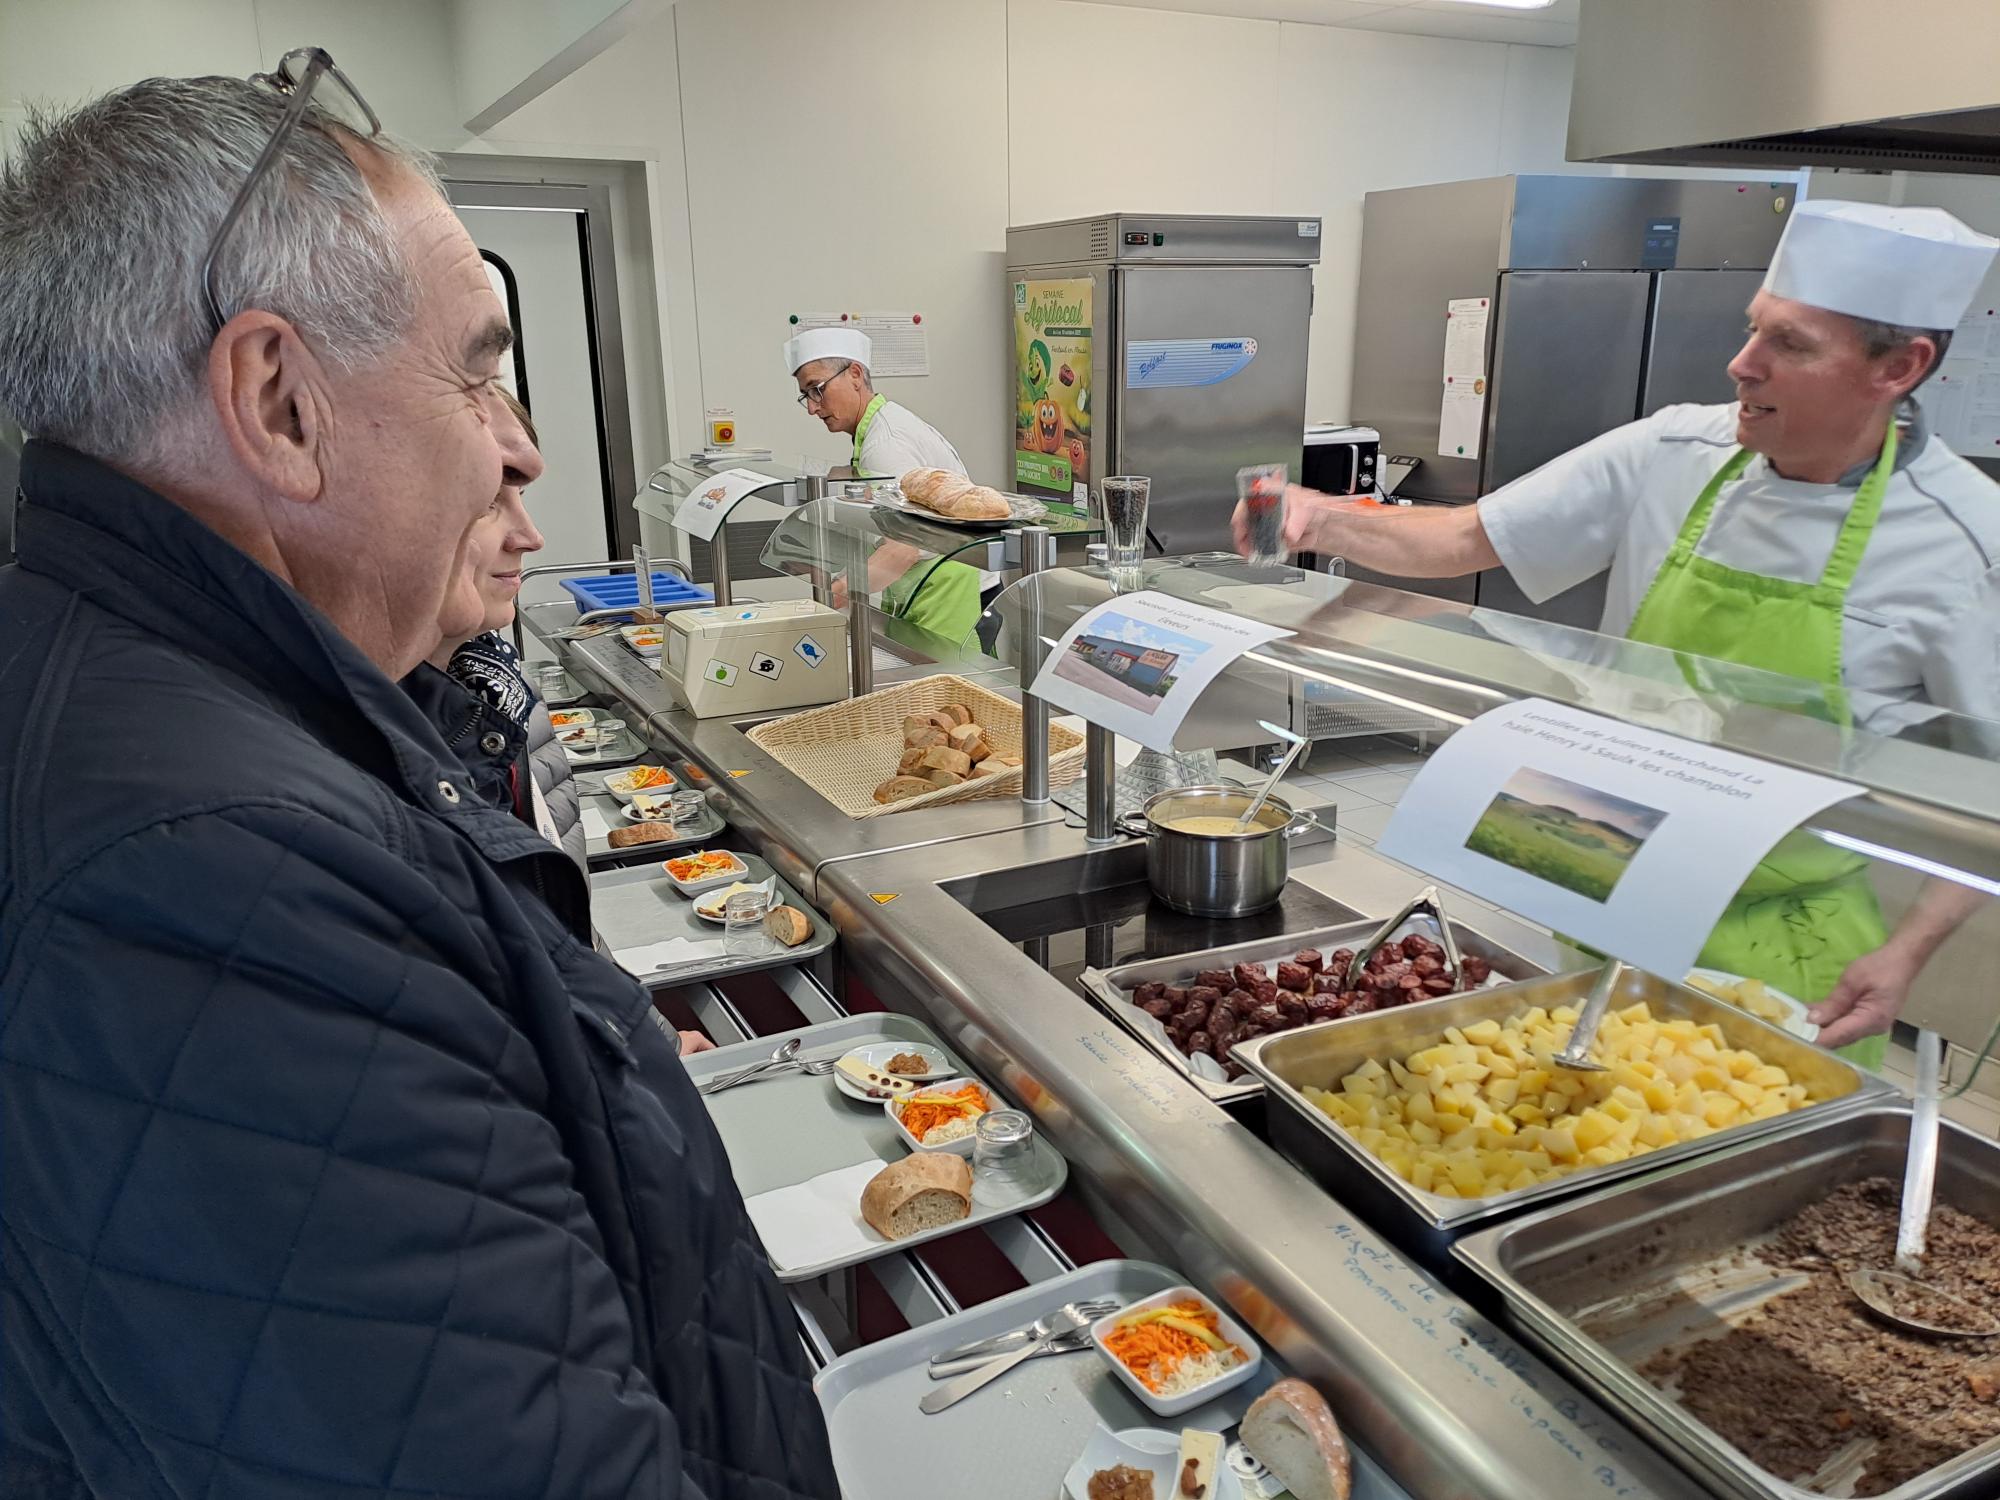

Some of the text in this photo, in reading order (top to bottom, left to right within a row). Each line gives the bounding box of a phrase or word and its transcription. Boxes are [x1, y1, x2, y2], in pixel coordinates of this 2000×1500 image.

[1024, 296, 1084, 331] Agrilocal
[1042, 289, 1064, 299] SEMAINE
[1211, 342, 1243, 351] FRIGINOX
[1522, 711, 1765, 785] Lentilles de Julien Marchand La
[1535, 729, 1578, 749] Henry
[1580, 742, 1590, 752] à
[1592, 747, 1634, 766] Saulx
[1638, 759, 1661, 773] les
[1664, 767, 1752, 800] champlon
[1076, 1035, 1108, 1064] Sauce
[1342, 1256, 1407, 1313] Pommes
[1411, 1315, 1440, 1341] de
[1408, 1281, 1435, 1305] de
[1554, 1398, 1622, 1452] Bio
